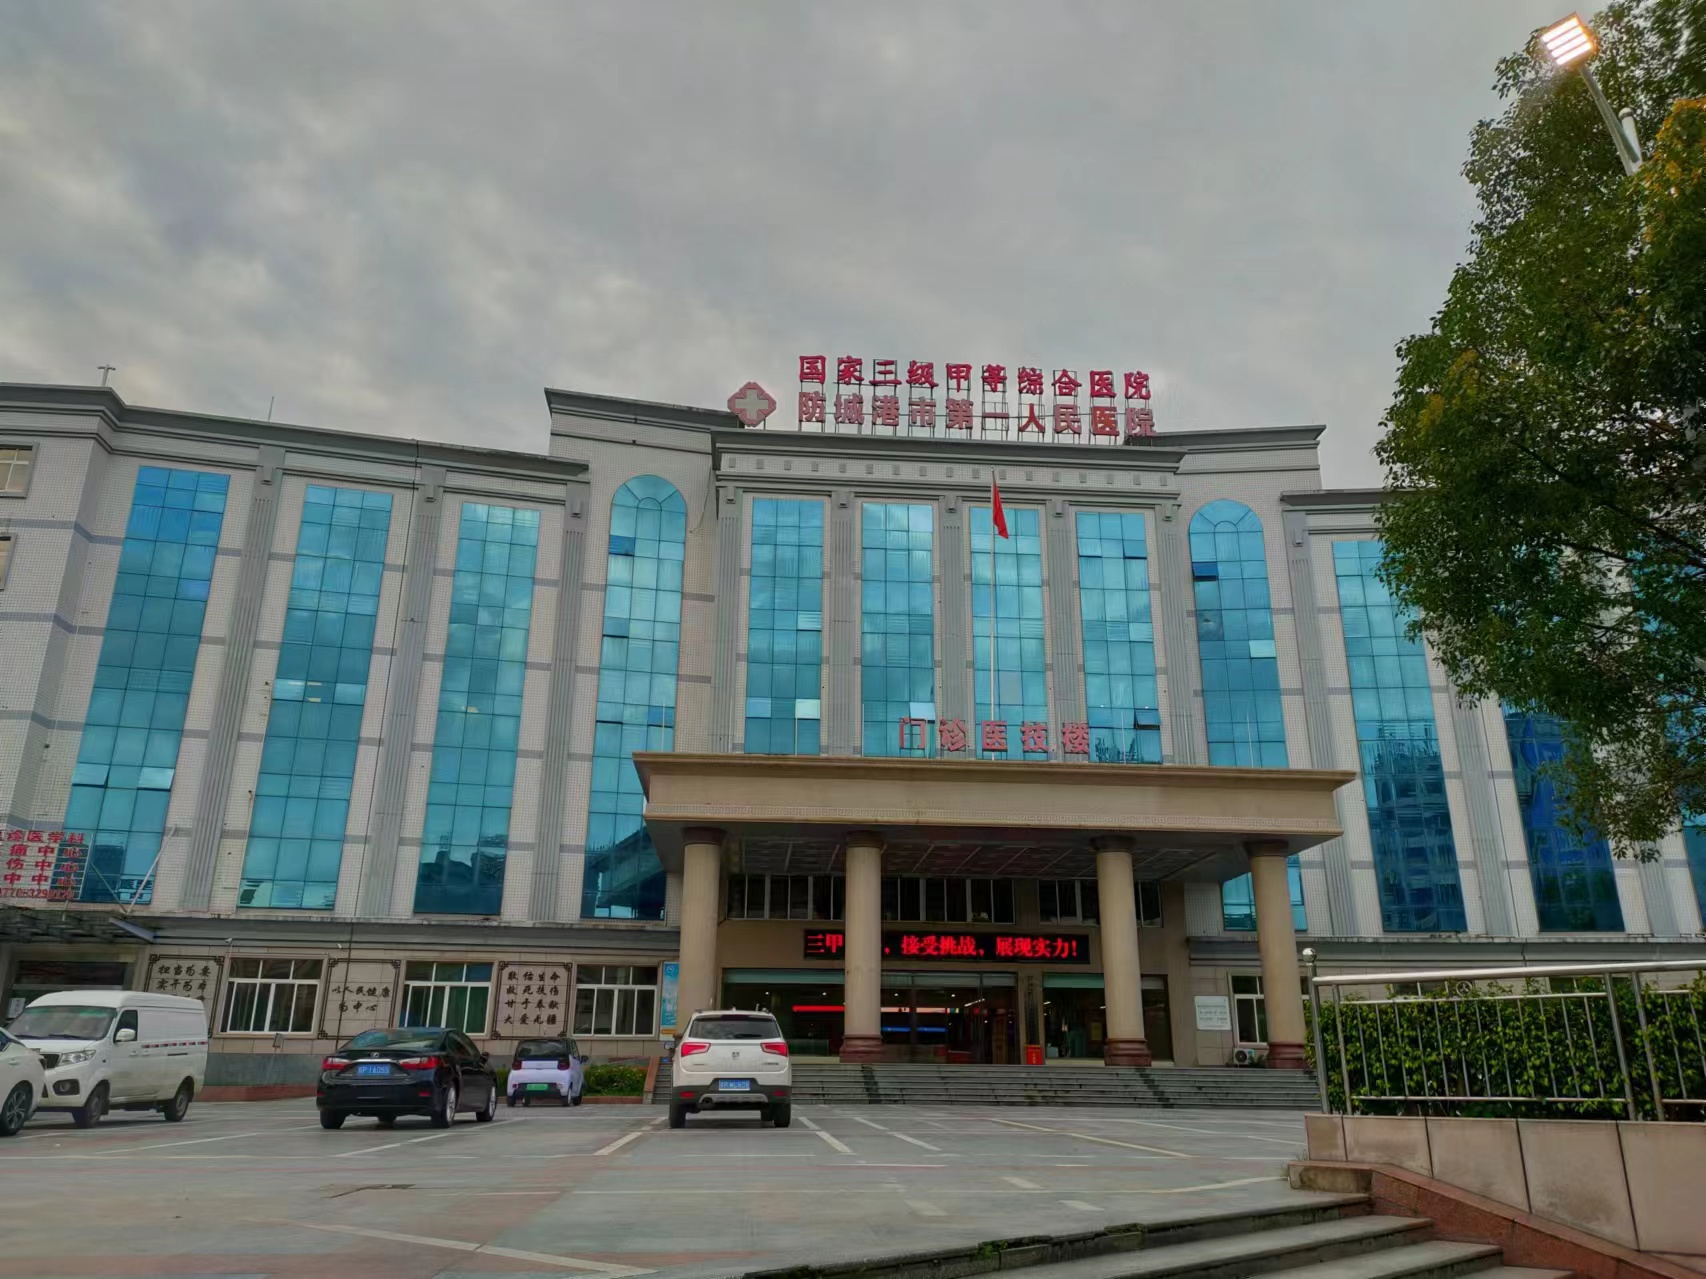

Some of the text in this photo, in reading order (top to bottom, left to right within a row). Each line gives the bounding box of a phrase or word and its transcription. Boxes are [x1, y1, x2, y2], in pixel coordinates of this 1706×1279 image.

[799, 355, 1151, 399] 国家三级甲等综合医院
[799, 391, 1156, 437] 防城港市第一人民医院
[900, 716, 1089, 752] 门诊医技楼
[0, 829, 84, 845] 诊医学科
[332, 985, 390, 998] 以人民健康
